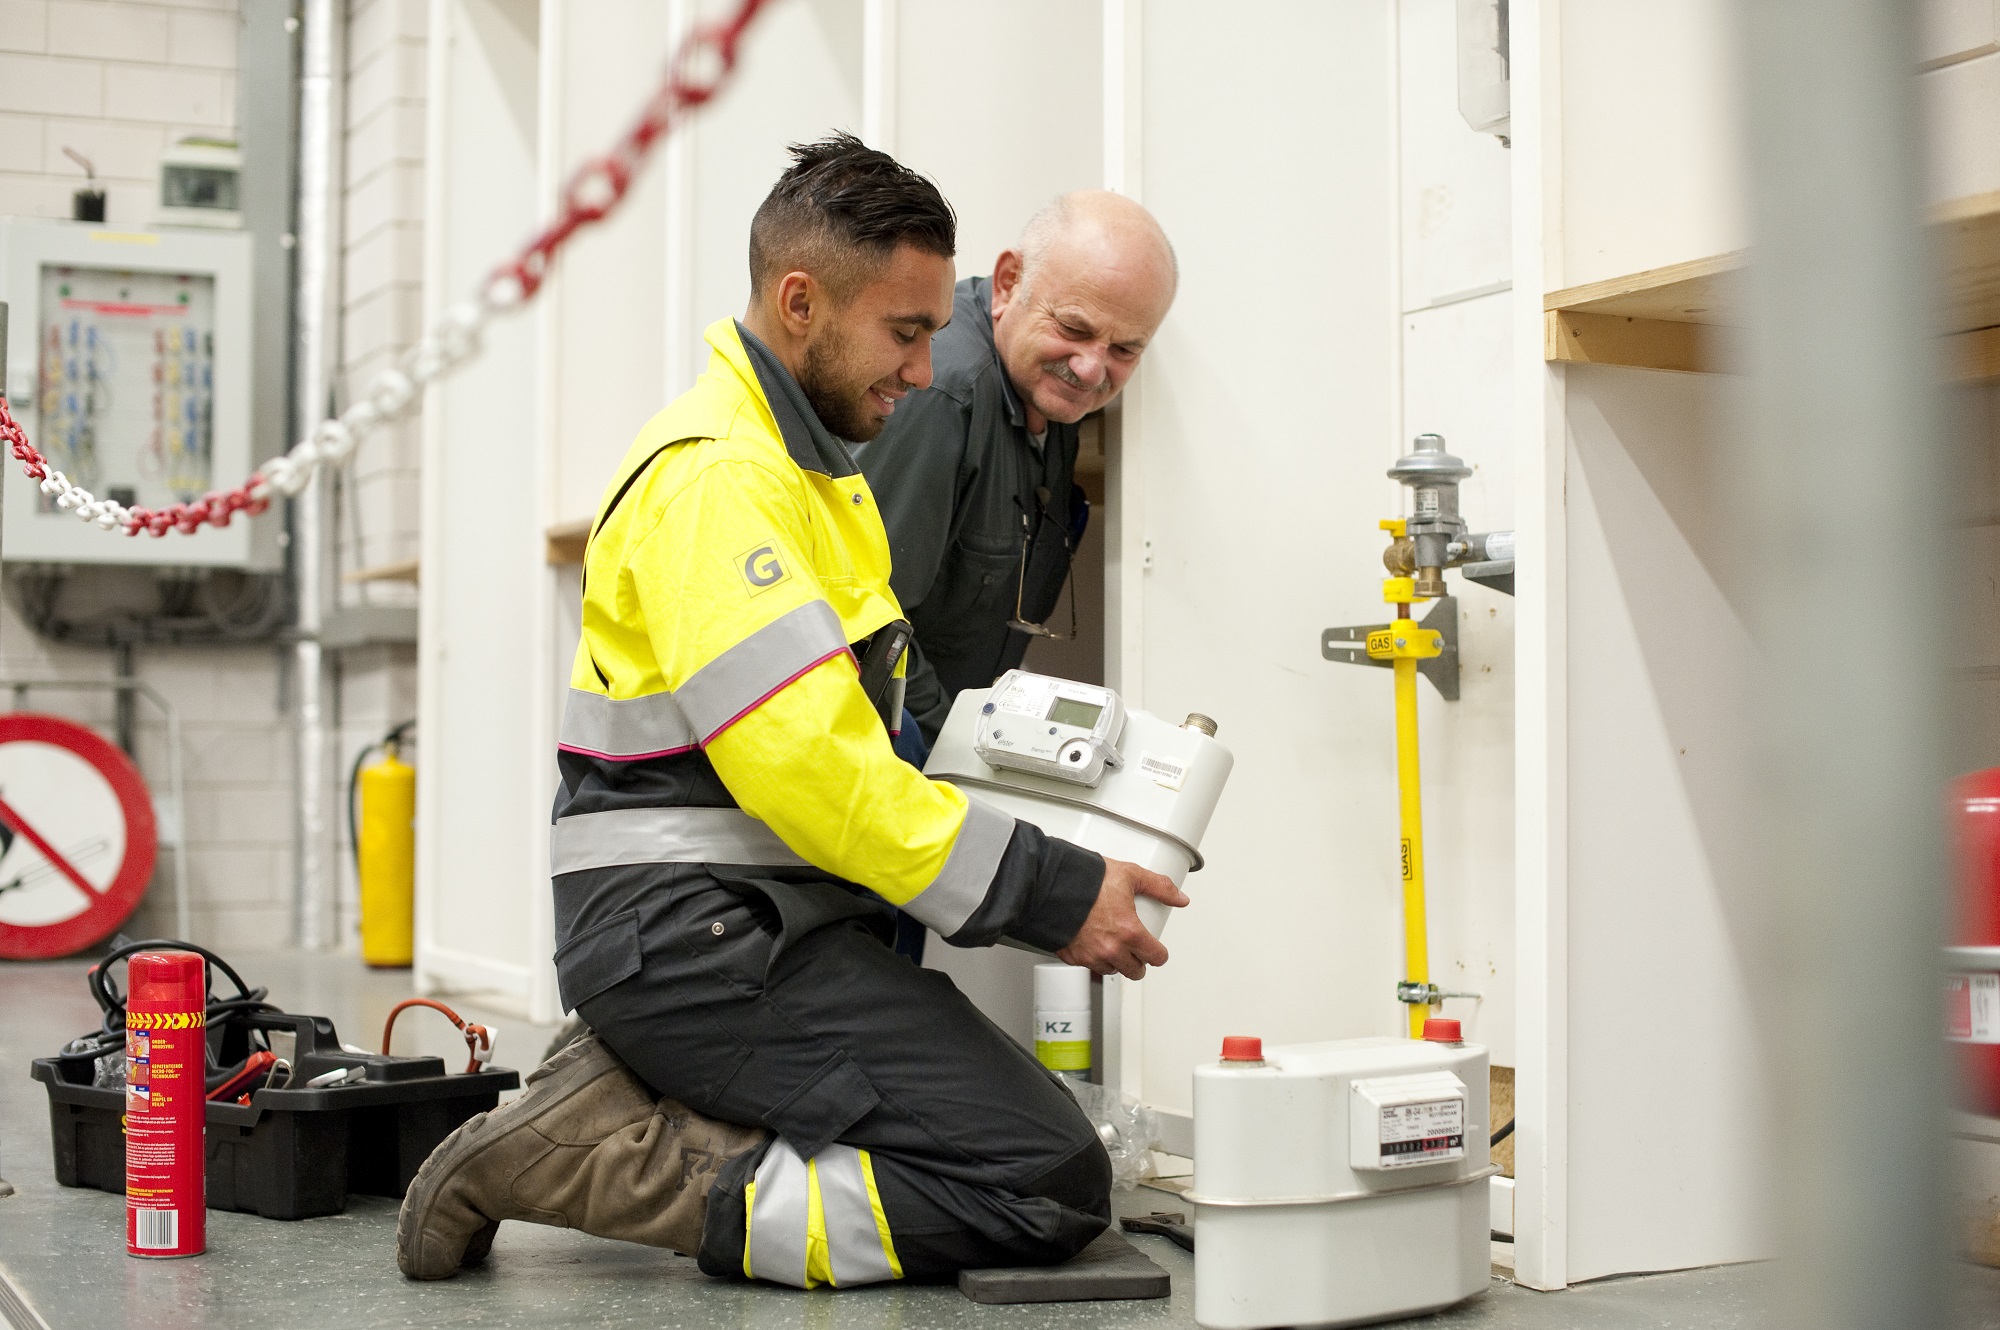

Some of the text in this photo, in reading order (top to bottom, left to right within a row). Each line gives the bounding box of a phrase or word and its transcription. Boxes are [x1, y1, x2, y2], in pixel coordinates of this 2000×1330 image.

[744, 546, 784, 587] G
[1370, 636, 1390, 651] GAS
[997, 739, 1015, 747] elster
[1401, 843, 1409, 876] GAS
[1045, 1021, 1072, 1034] KZ
